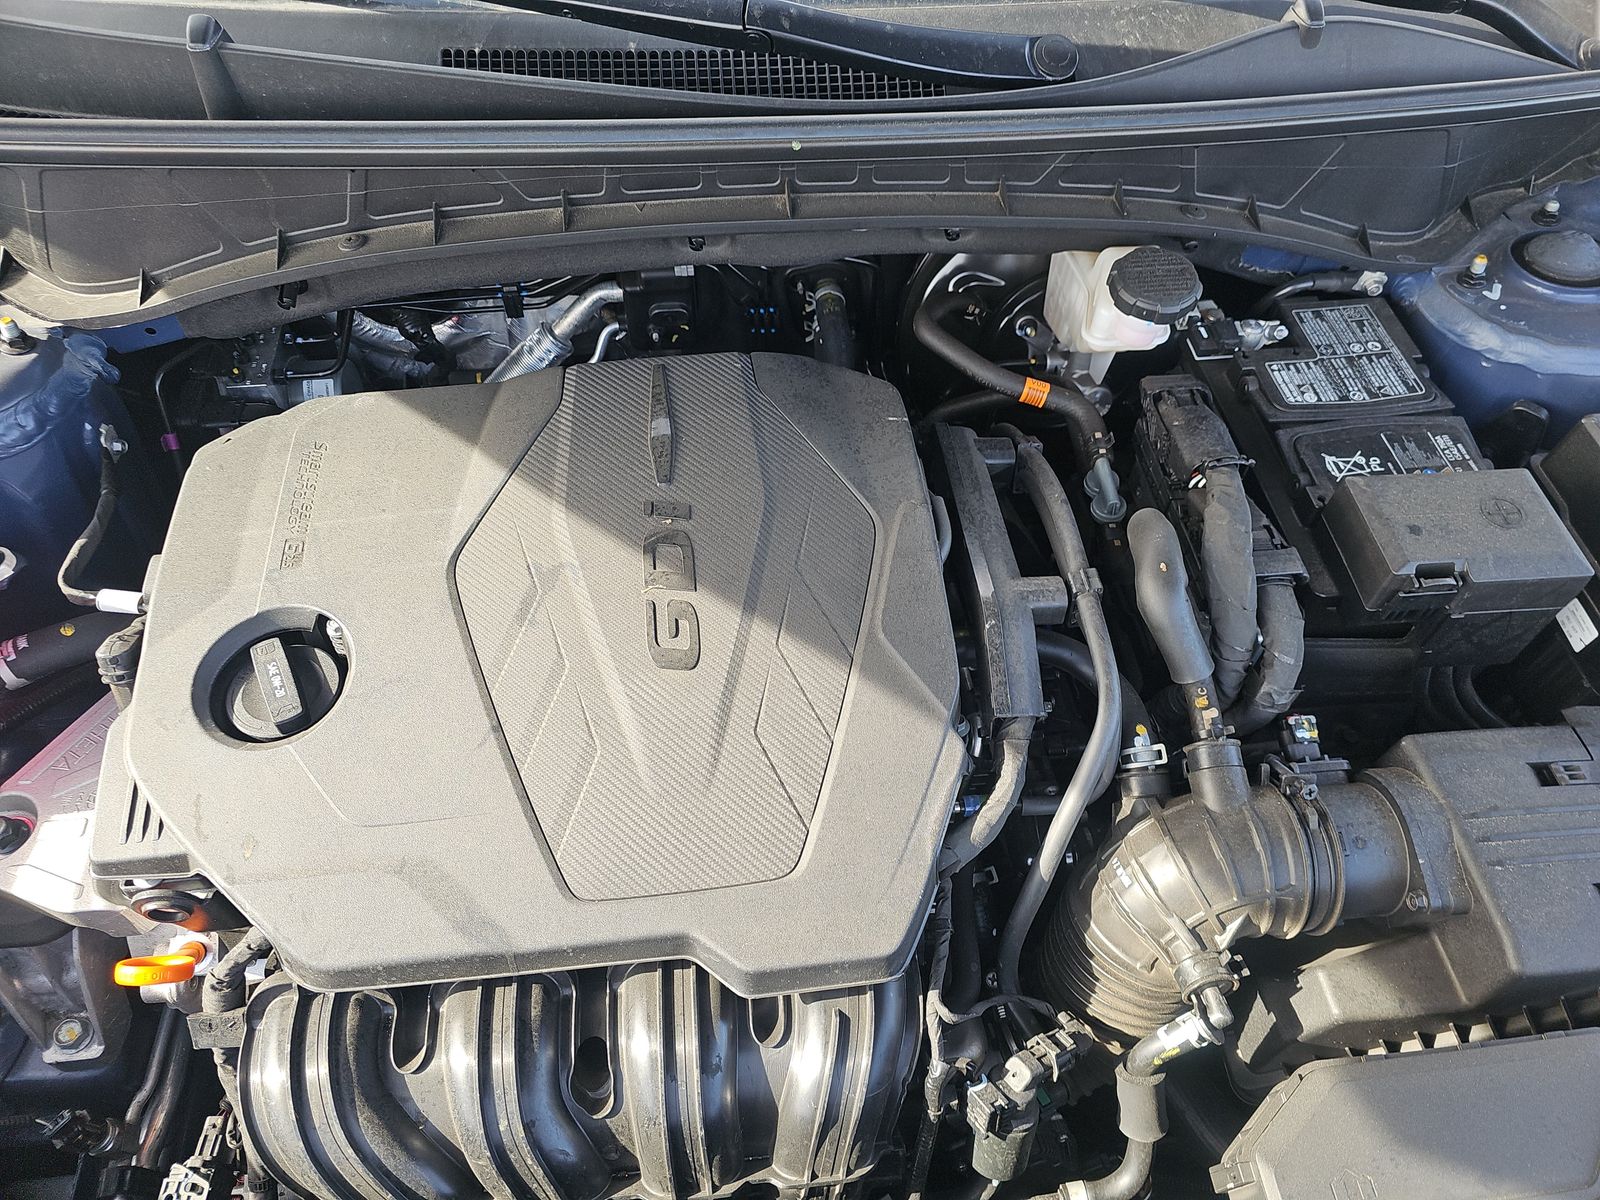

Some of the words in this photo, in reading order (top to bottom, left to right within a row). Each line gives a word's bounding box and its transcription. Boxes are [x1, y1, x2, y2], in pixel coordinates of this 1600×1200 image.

[299, 440, 328, 535] Smartstream
[1369, 456, 1385, 471] Pb
[288, 451, 311, 535] TECHNOLOGY
[643, 500, 700, 671] GDi
[267, 661, 280, 677] SAE
[271, 675, 286, 698] 0W-20
